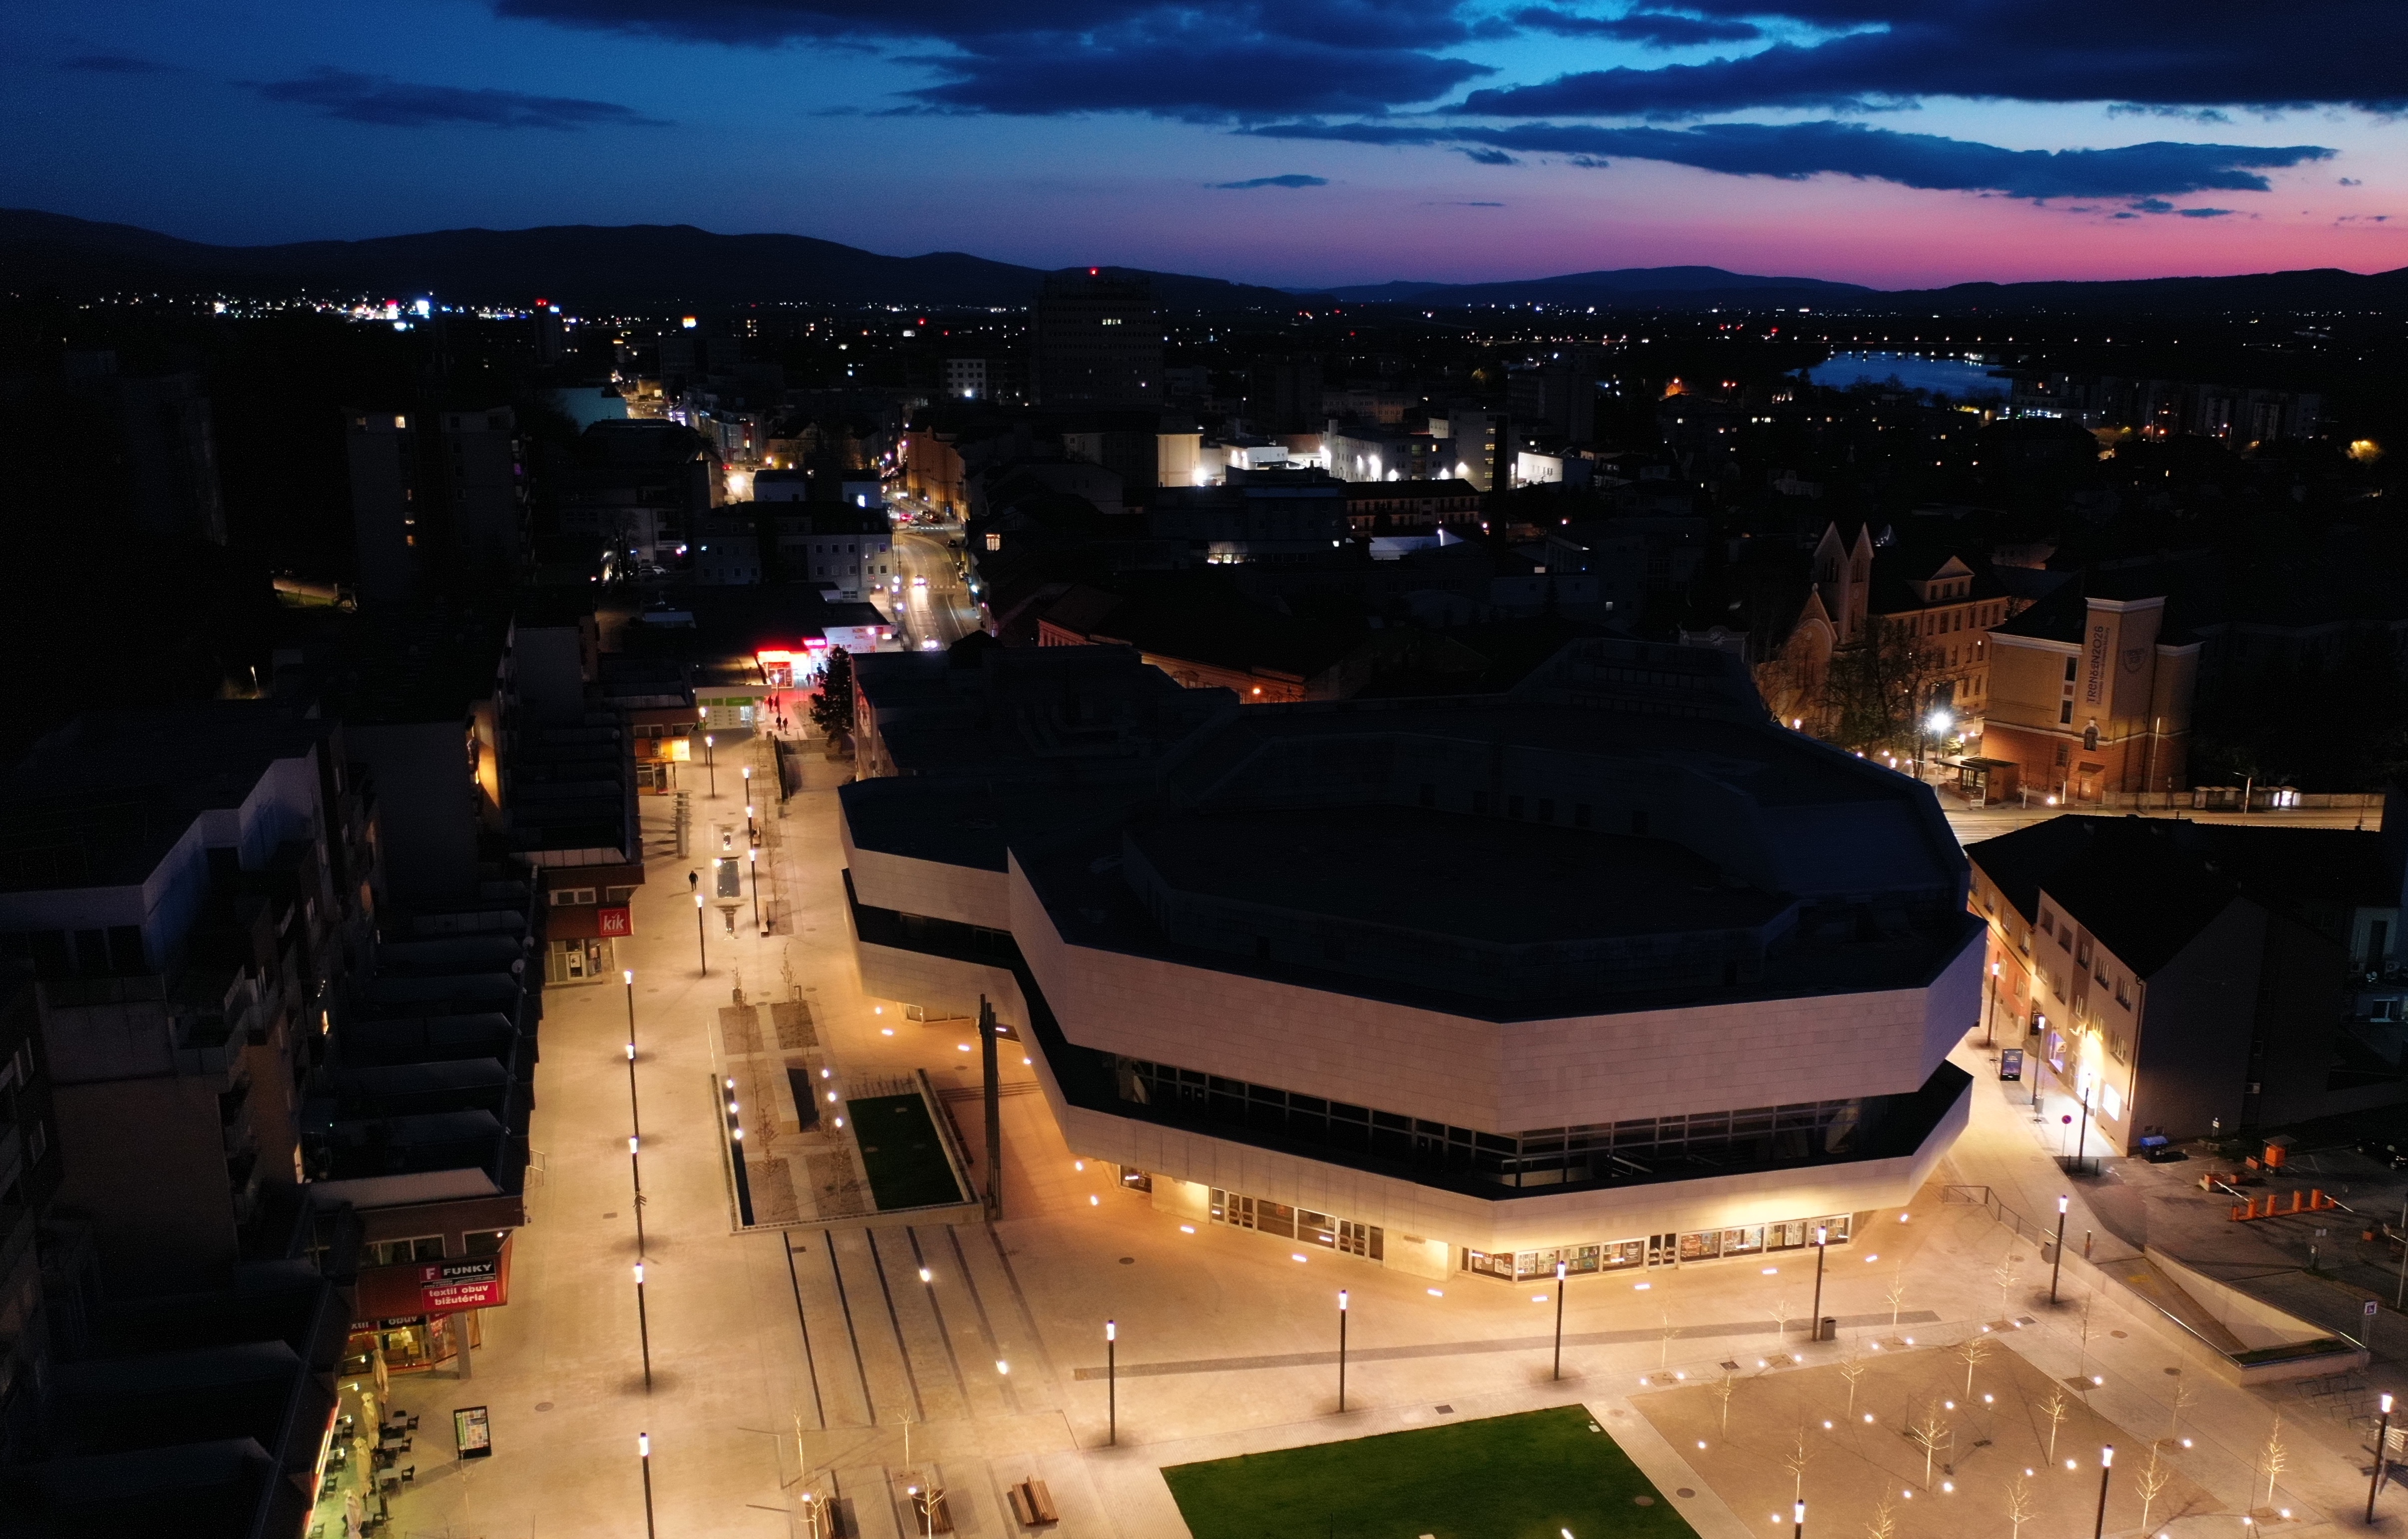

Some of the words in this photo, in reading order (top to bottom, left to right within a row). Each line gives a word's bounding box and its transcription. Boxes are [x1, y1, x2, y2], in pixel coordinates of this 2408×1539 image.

[426, 1267, 435, 1279] F
[443, 1264, 492, 1275] FUNKY
[429, 1287, 457, 1297] textil
[461, 1284, 488, 1293] obuv
[434, 1294, 485, 1305] bižutéria
